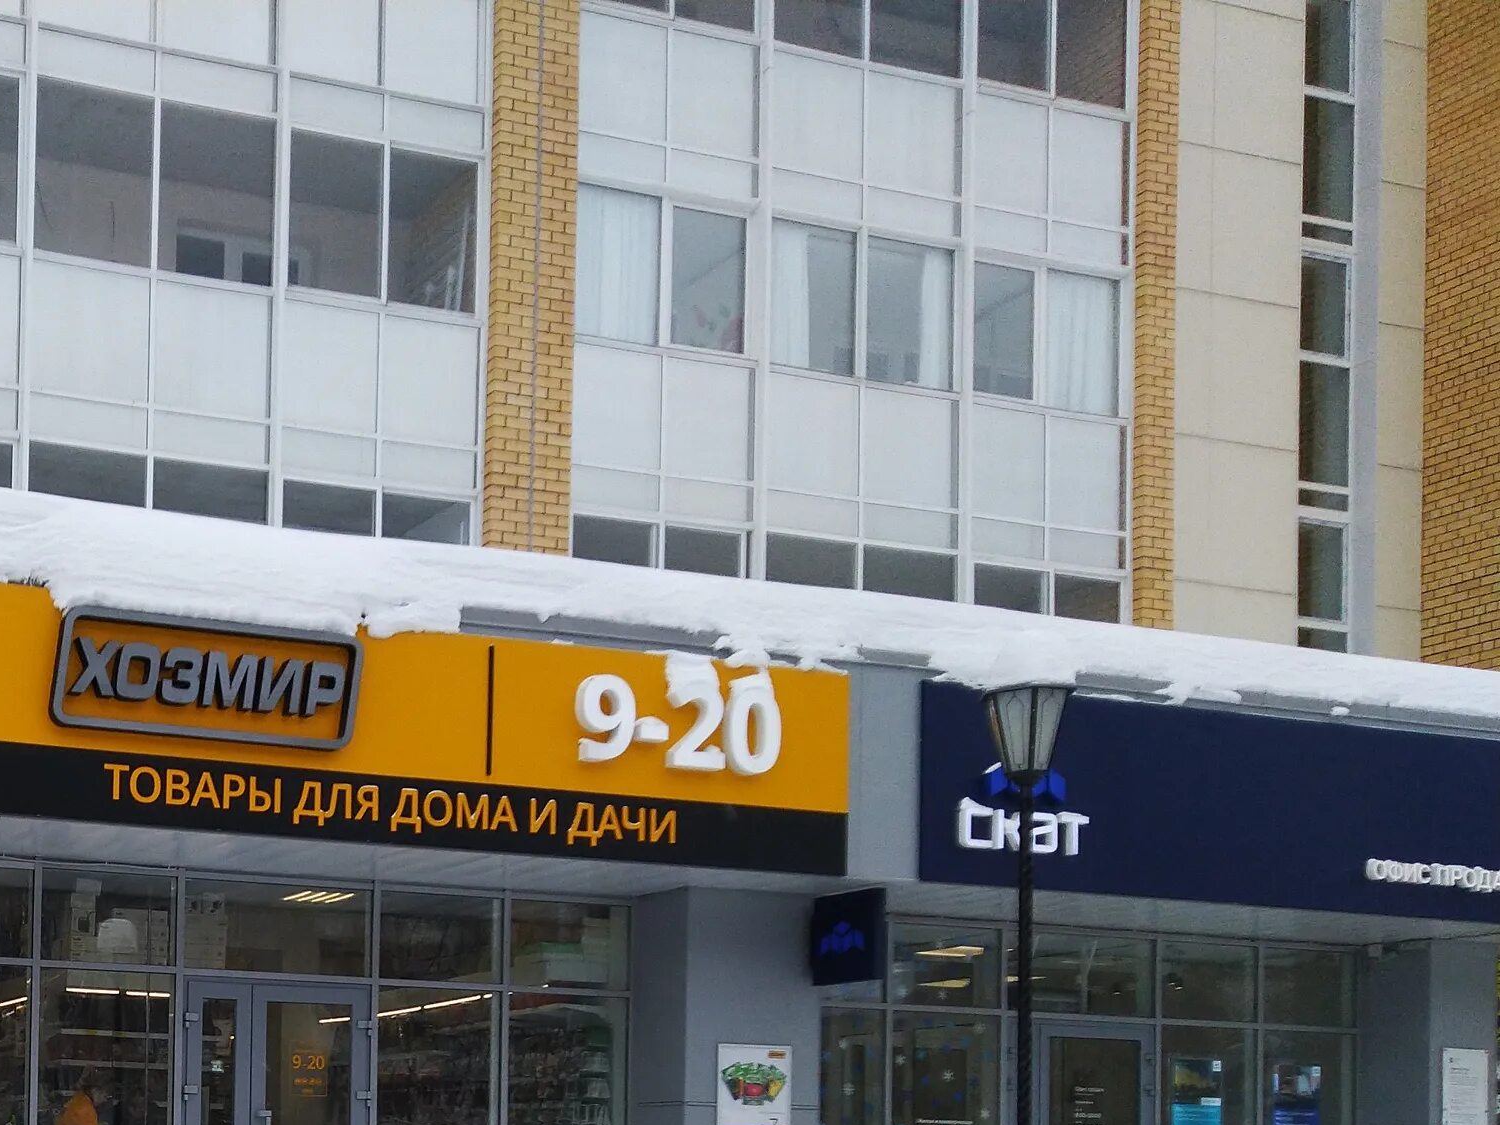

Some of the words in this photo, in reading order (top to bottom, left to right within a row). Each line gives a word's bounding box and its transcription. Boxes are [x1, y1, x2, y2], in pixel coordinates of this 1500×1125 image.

[68, 636, 346, 718] ХОЗМИР
[575, 674, 782, 777] 9-20
[103, 762, 282, 814] ТОВАРЫ
[292, 780, 380, 826] ДЛЯ
[390, 786, 518, 834] ДОМА
[529, 797, 558, 836] И
[567, 801, 677, 847] ДАЧИ
[1365, 858, 1432, 885] ОФИС
